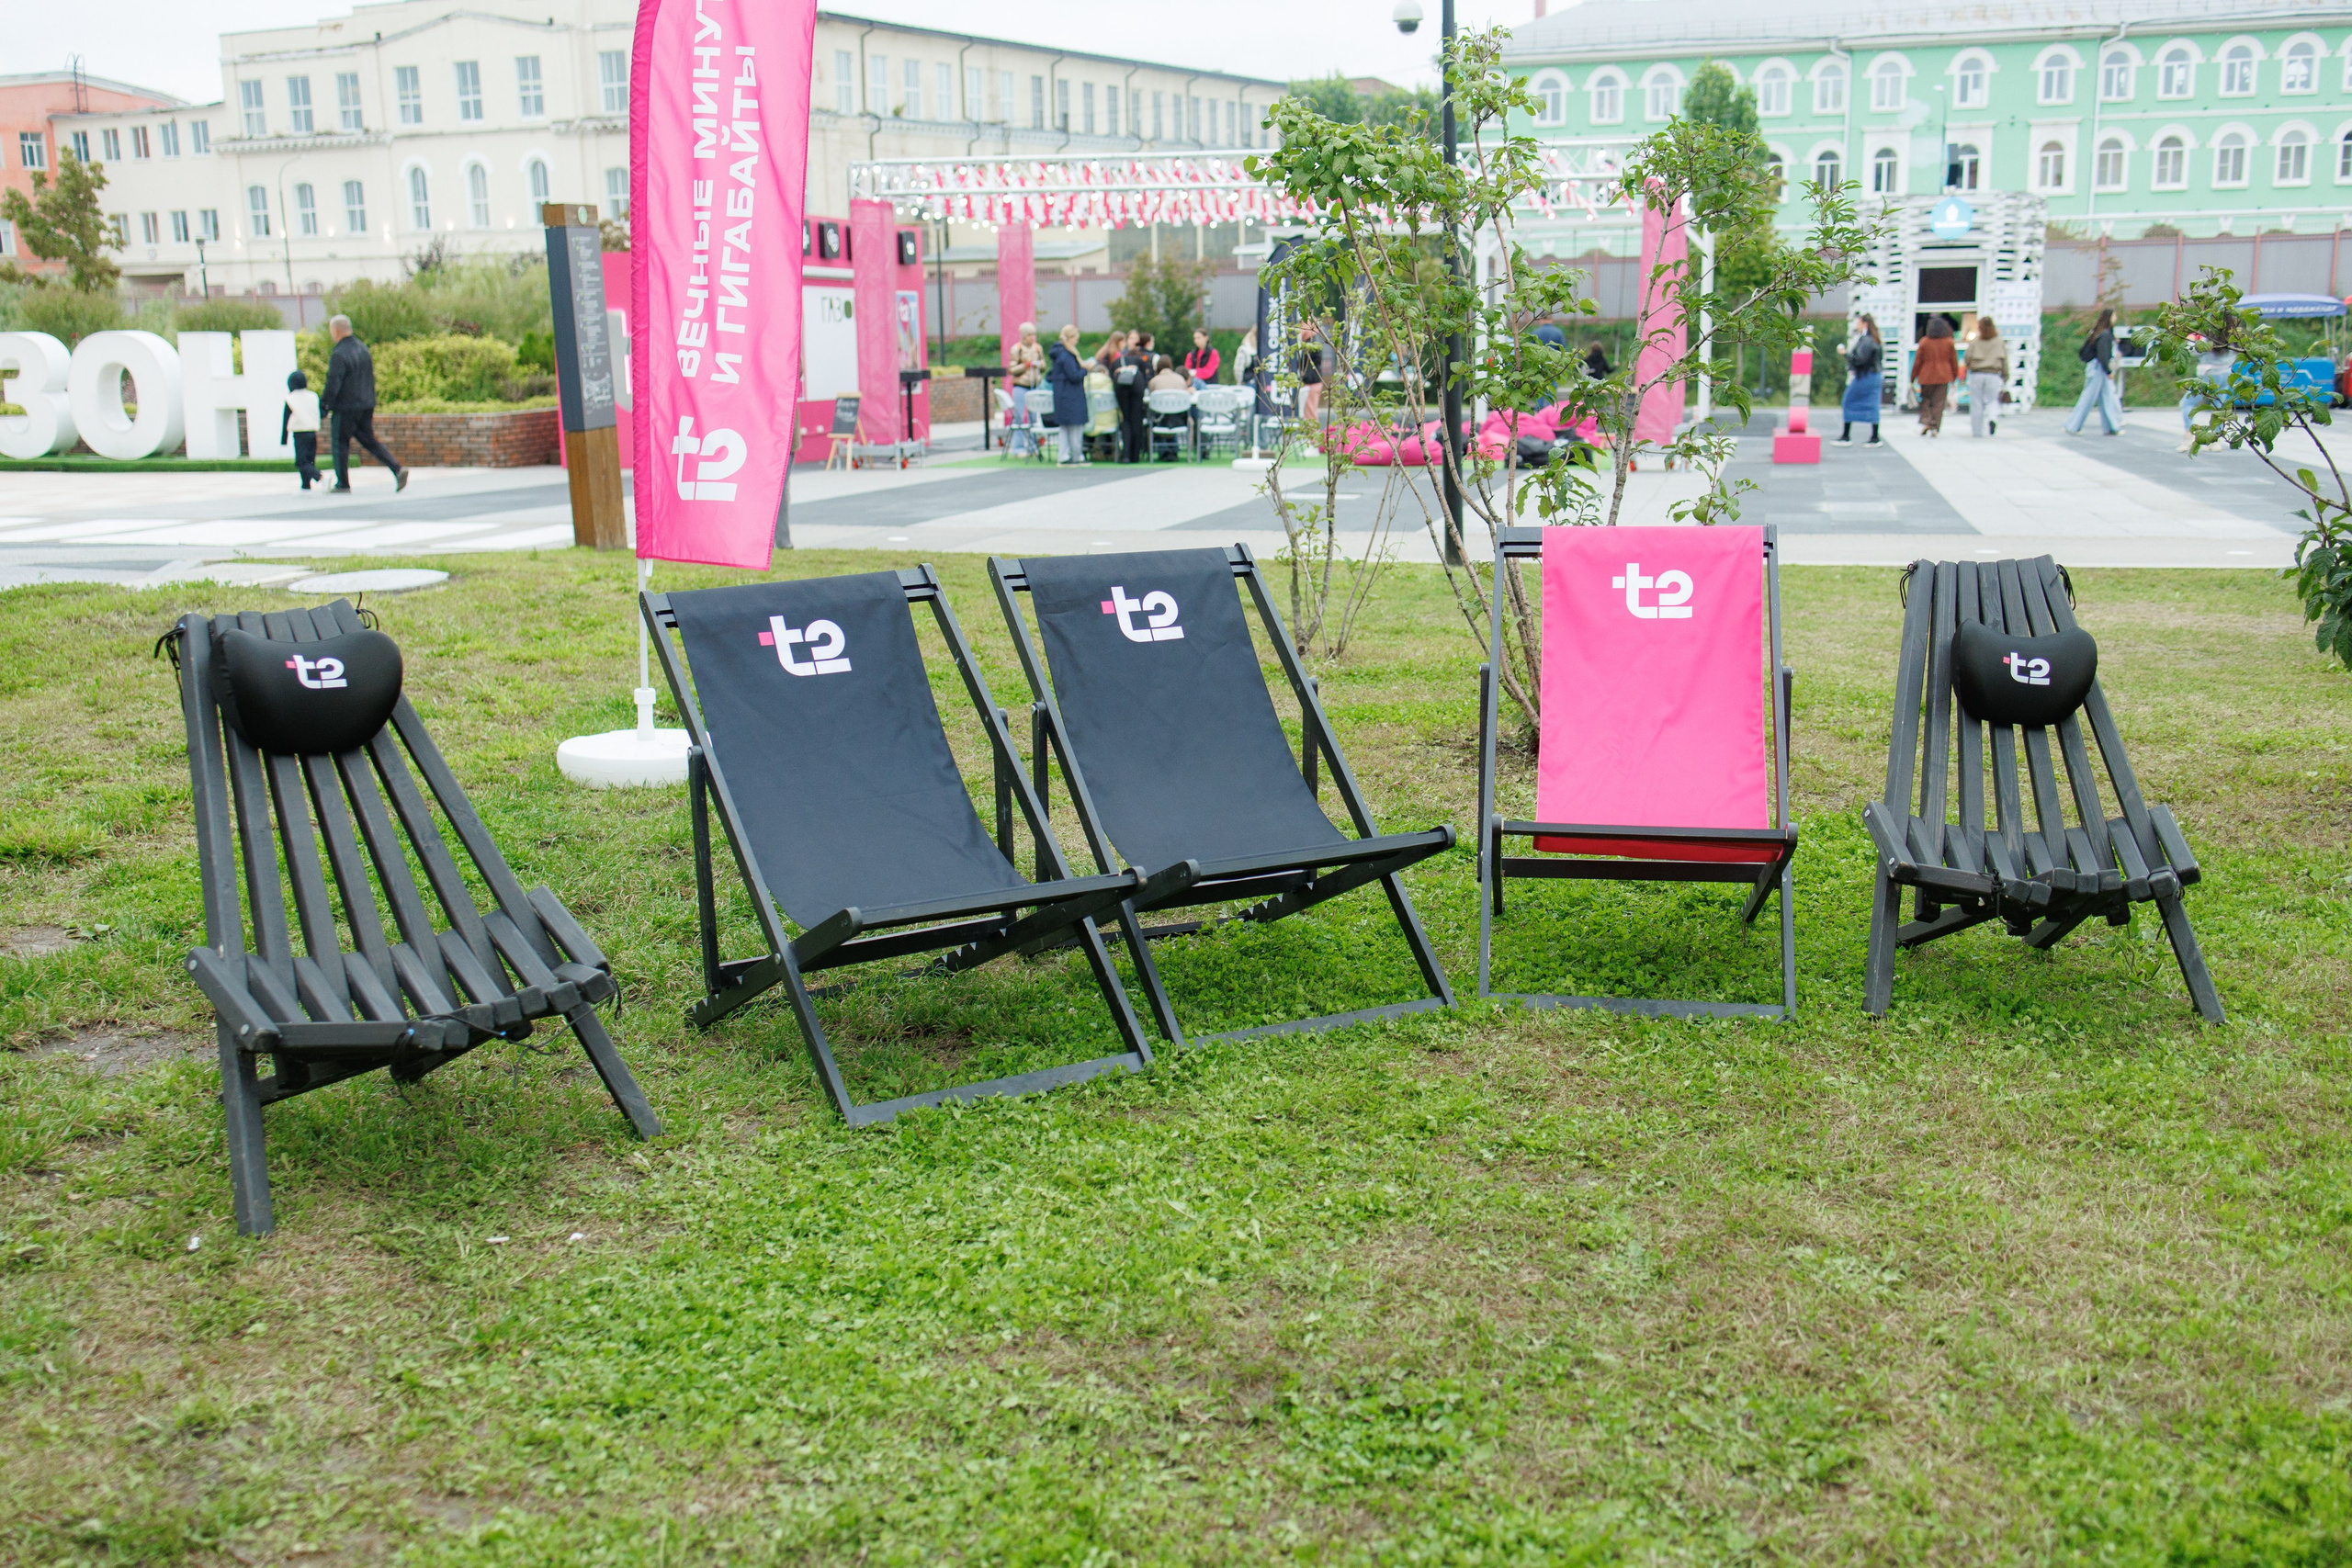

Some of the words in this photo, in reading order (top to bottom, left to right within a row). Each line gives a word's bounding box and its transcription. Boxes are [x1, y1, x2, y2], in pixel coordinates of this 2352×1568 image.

[716, 46, 760, 333] ГИГАБАЙТЫ
[676, 179, 714, 378] ВЕЧНЫЕ
[710, 352, 742, 384] И
[671, 415, 747, 502] t2
[1101, 586, 1185, 643] t2
[1612, 562, 1694, 619] t2
[285, 654, 348, 689] t2
[758, 615, 852, 677] t2
[2003, 652, 2051, 685] t2
